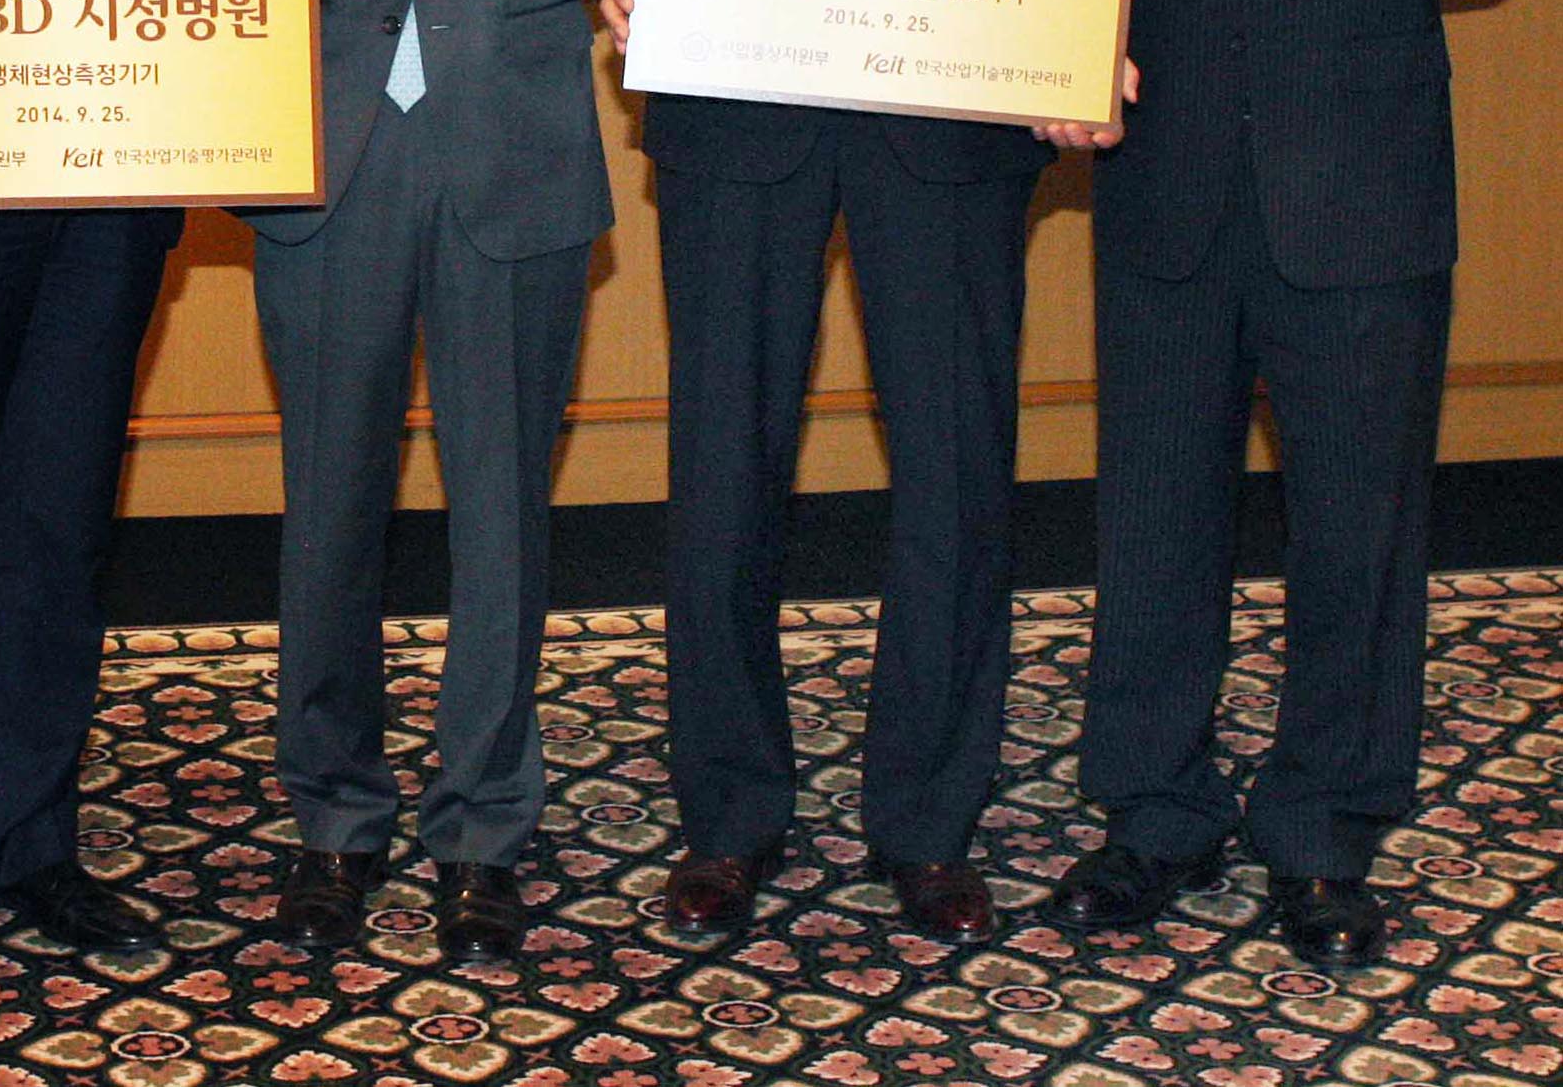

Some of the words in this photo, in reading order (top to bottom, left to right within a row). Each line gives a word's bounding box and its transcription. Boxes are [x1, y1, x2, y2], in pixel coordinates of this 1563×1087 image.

[823, 8, 875, 29] 2014.
[907, 16, 935, 33] 25.
[863, 52, 906, 75] Keit
[915, 59, 1073, 89] 한국산업기술평가관리원
[16, 107, 70, 123] 2014.
[77, 106, 94, 123] 9.
[102, 106, 131, 122] 25.
[63, 147, 104, 169] Keit
[114, 146, 273, 165] 한국산업기술평가관리원
